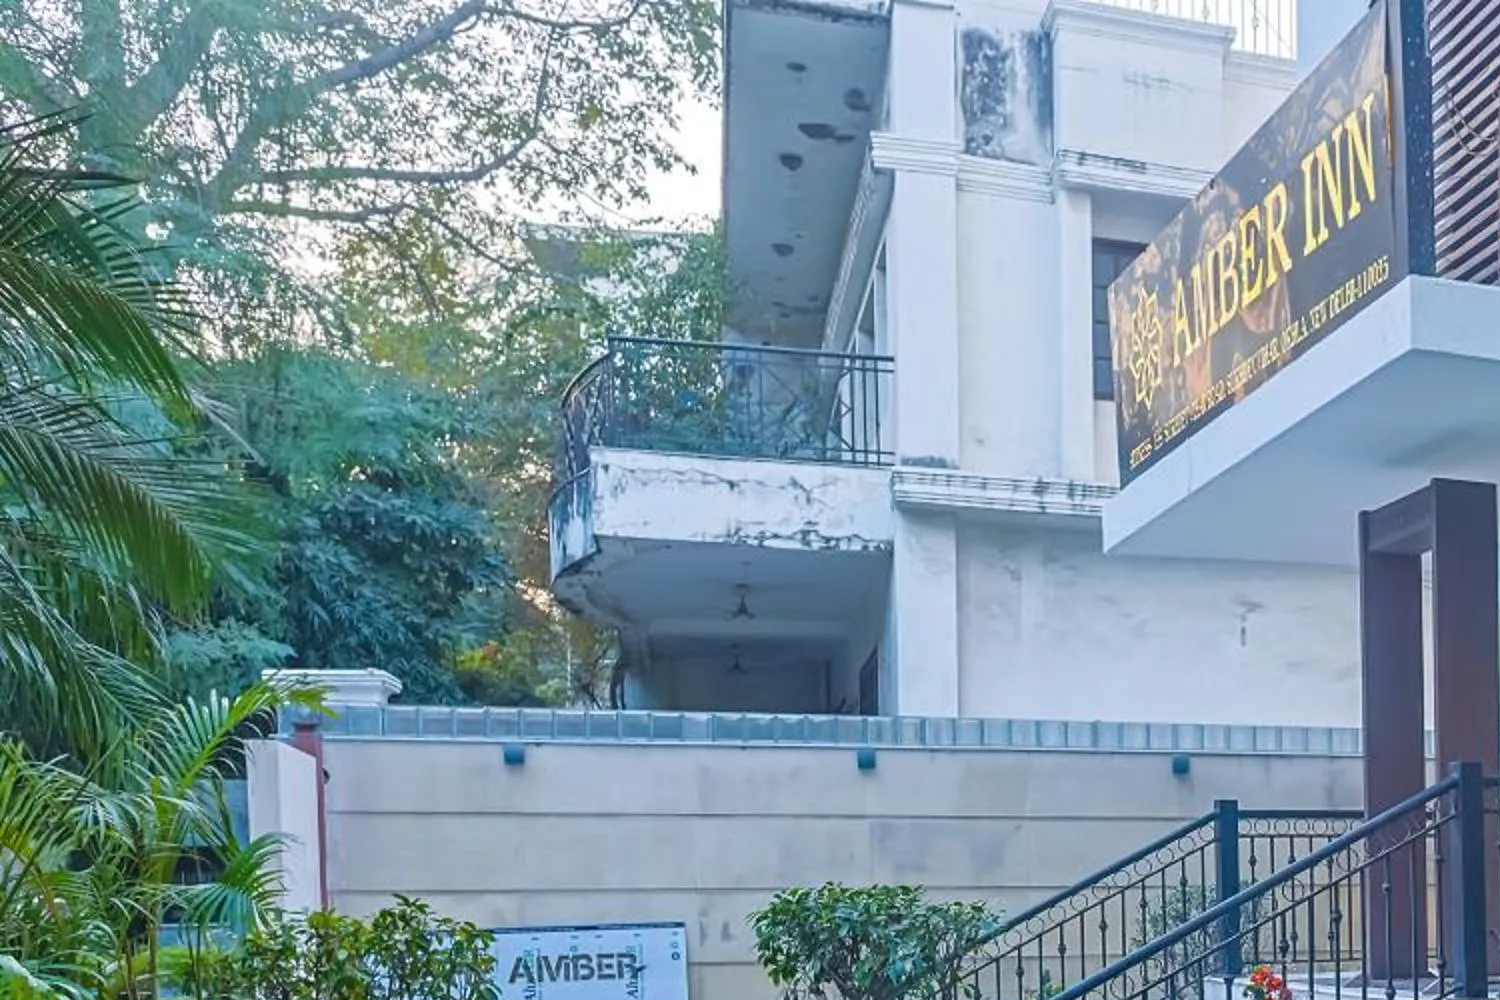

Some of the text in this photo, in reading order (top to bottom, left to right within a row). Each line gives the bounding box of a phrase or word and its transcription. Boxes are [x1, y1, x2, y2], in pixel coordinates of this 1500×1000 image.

[1173, 92, 1375, 368] AMBER INN
[508, 953, 648, 984] AMBER
